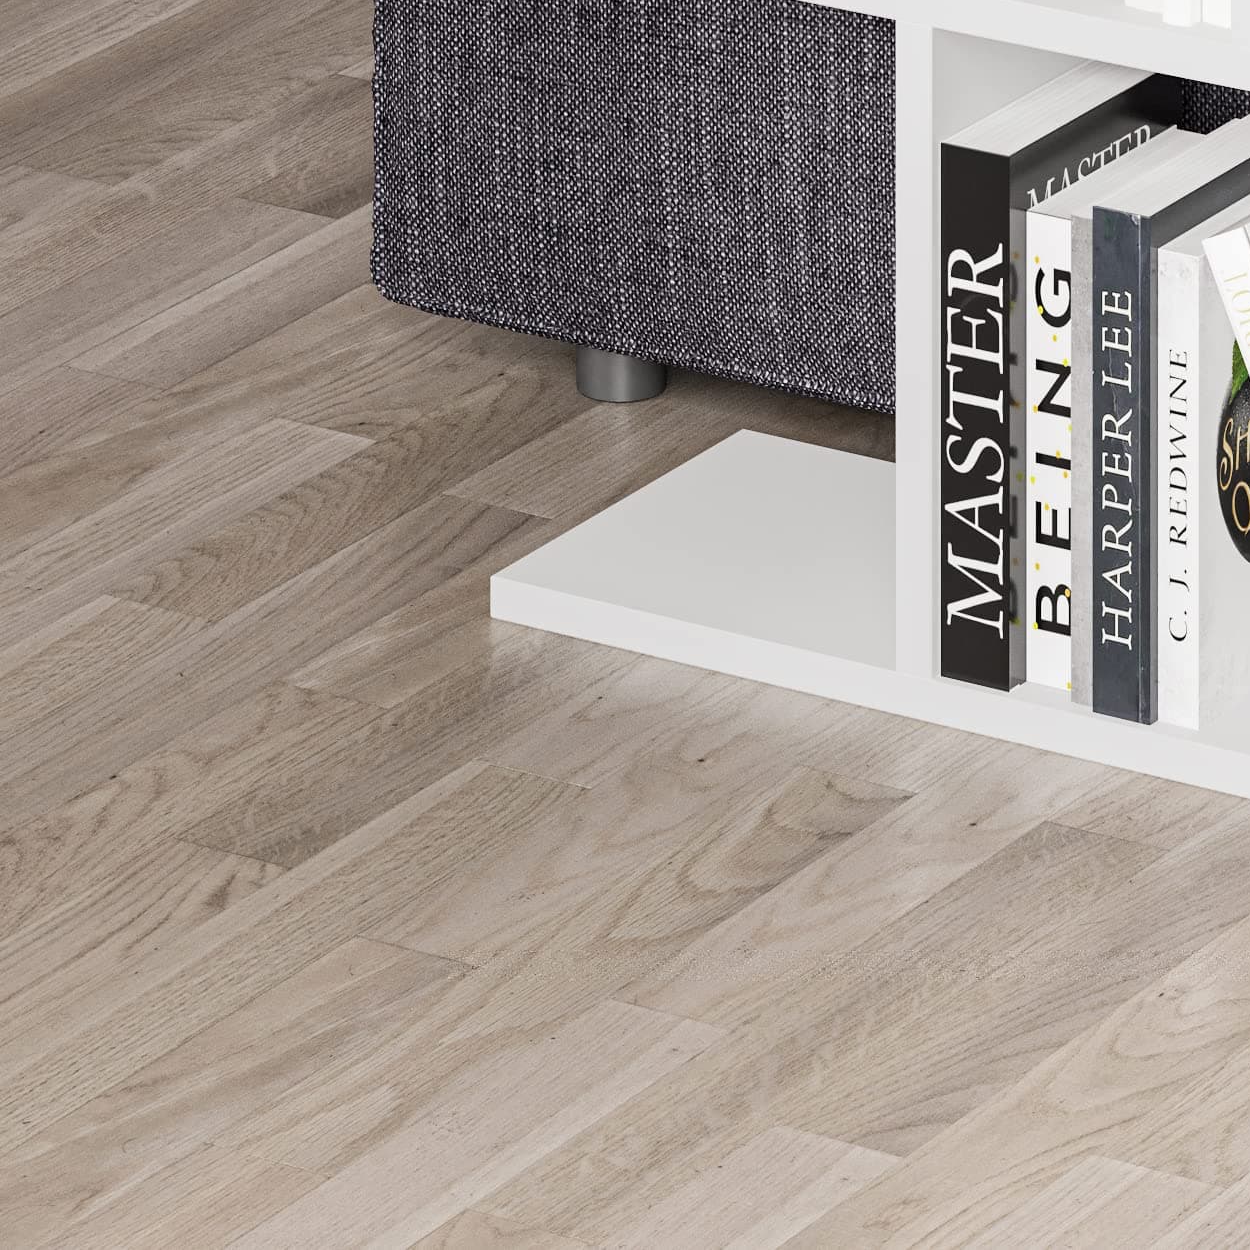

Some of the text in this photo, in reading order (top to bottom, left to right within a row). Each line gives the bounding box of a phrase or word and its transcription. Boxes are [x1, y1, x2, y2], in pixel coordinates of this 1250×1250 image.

[944, 243, 1006, 639] MASTER
[1035, 267, 1072, 636] BEING
[1101, 290, 1134, 651] HARPER LEE
[1169, 349, 1190, 642] C. J. REDWINE
